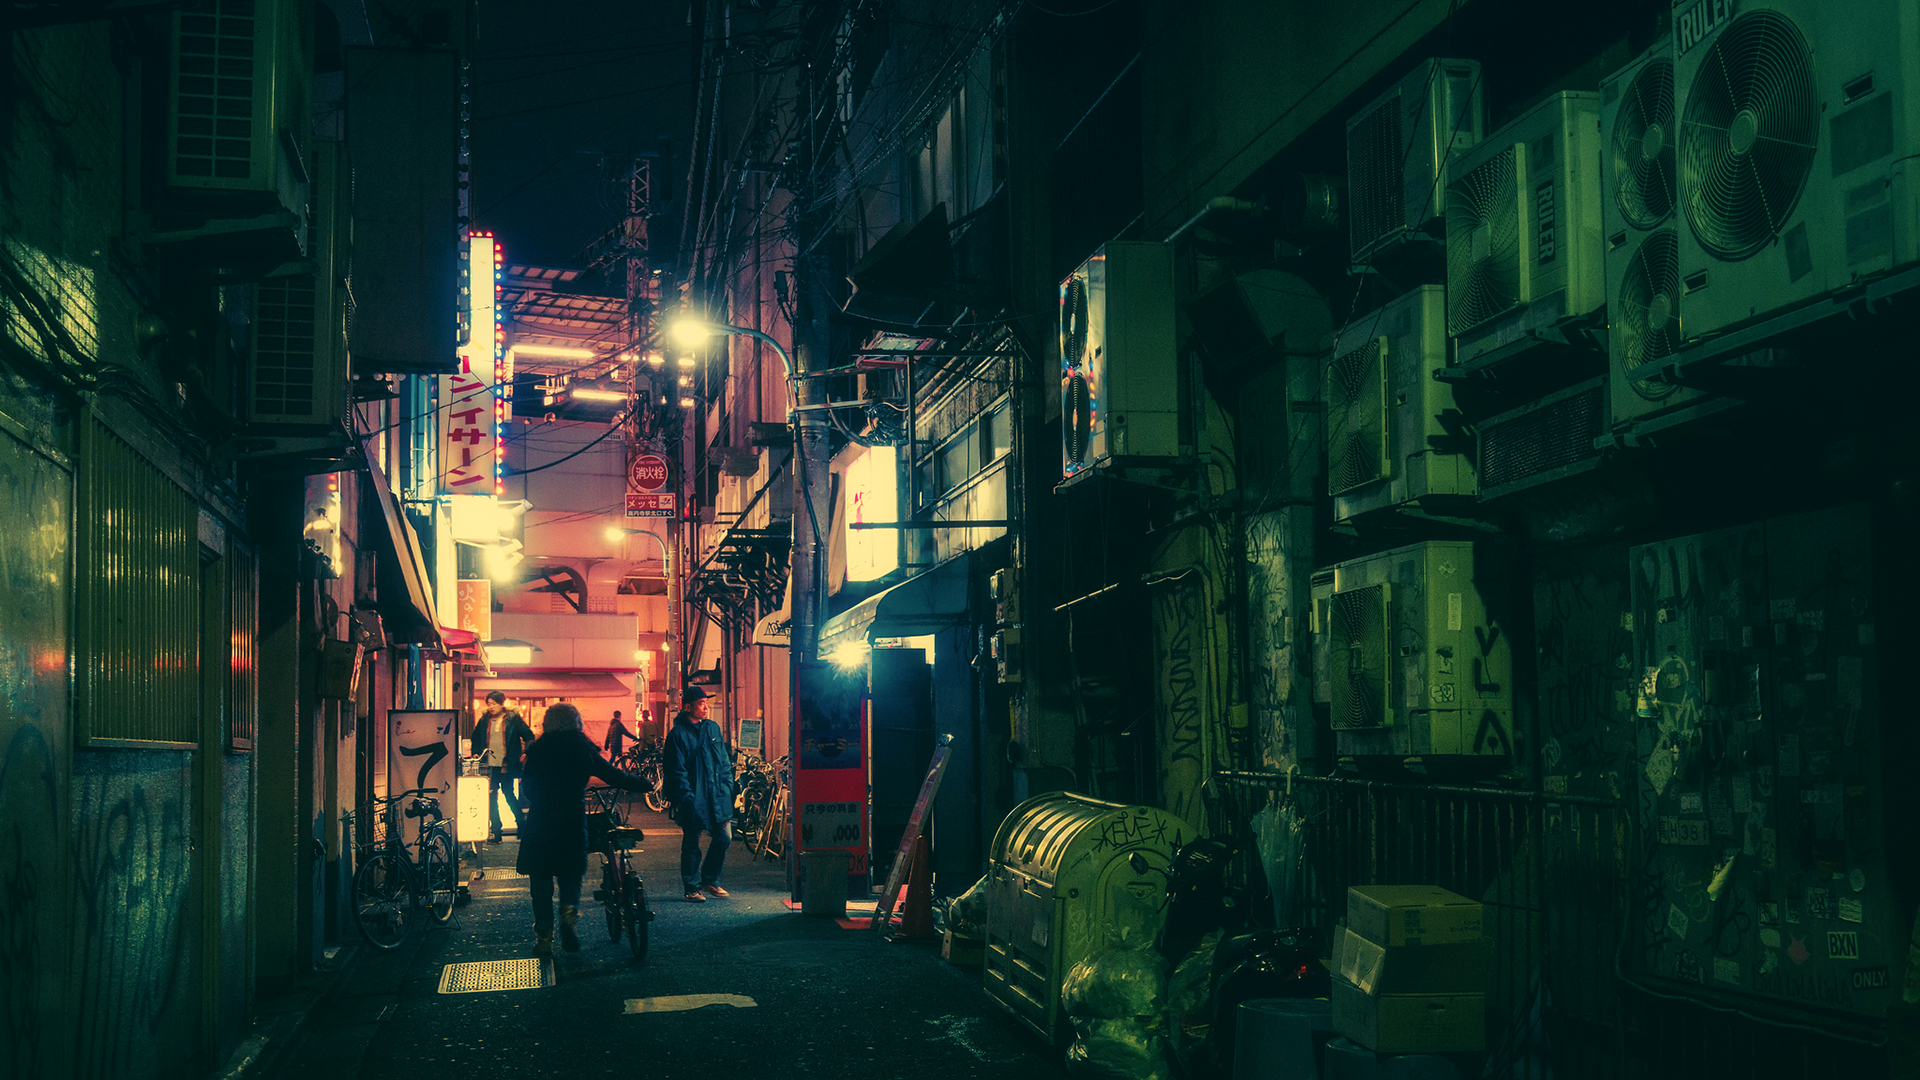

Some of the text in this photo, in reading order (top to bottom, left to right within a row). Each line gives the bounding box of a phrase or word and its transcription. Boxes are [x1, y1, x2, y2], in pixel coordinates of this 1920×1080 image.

[1537, 184, 1555, 260] RULER
[635, 466, 665, 480] 消火栓
[627, 499, 657, 509] メッセ
[803, 738, 860, 752] チャーミー
[806, 803, 857, 814] 只今の料金
[1828, 932, 1858, 958] BXN
